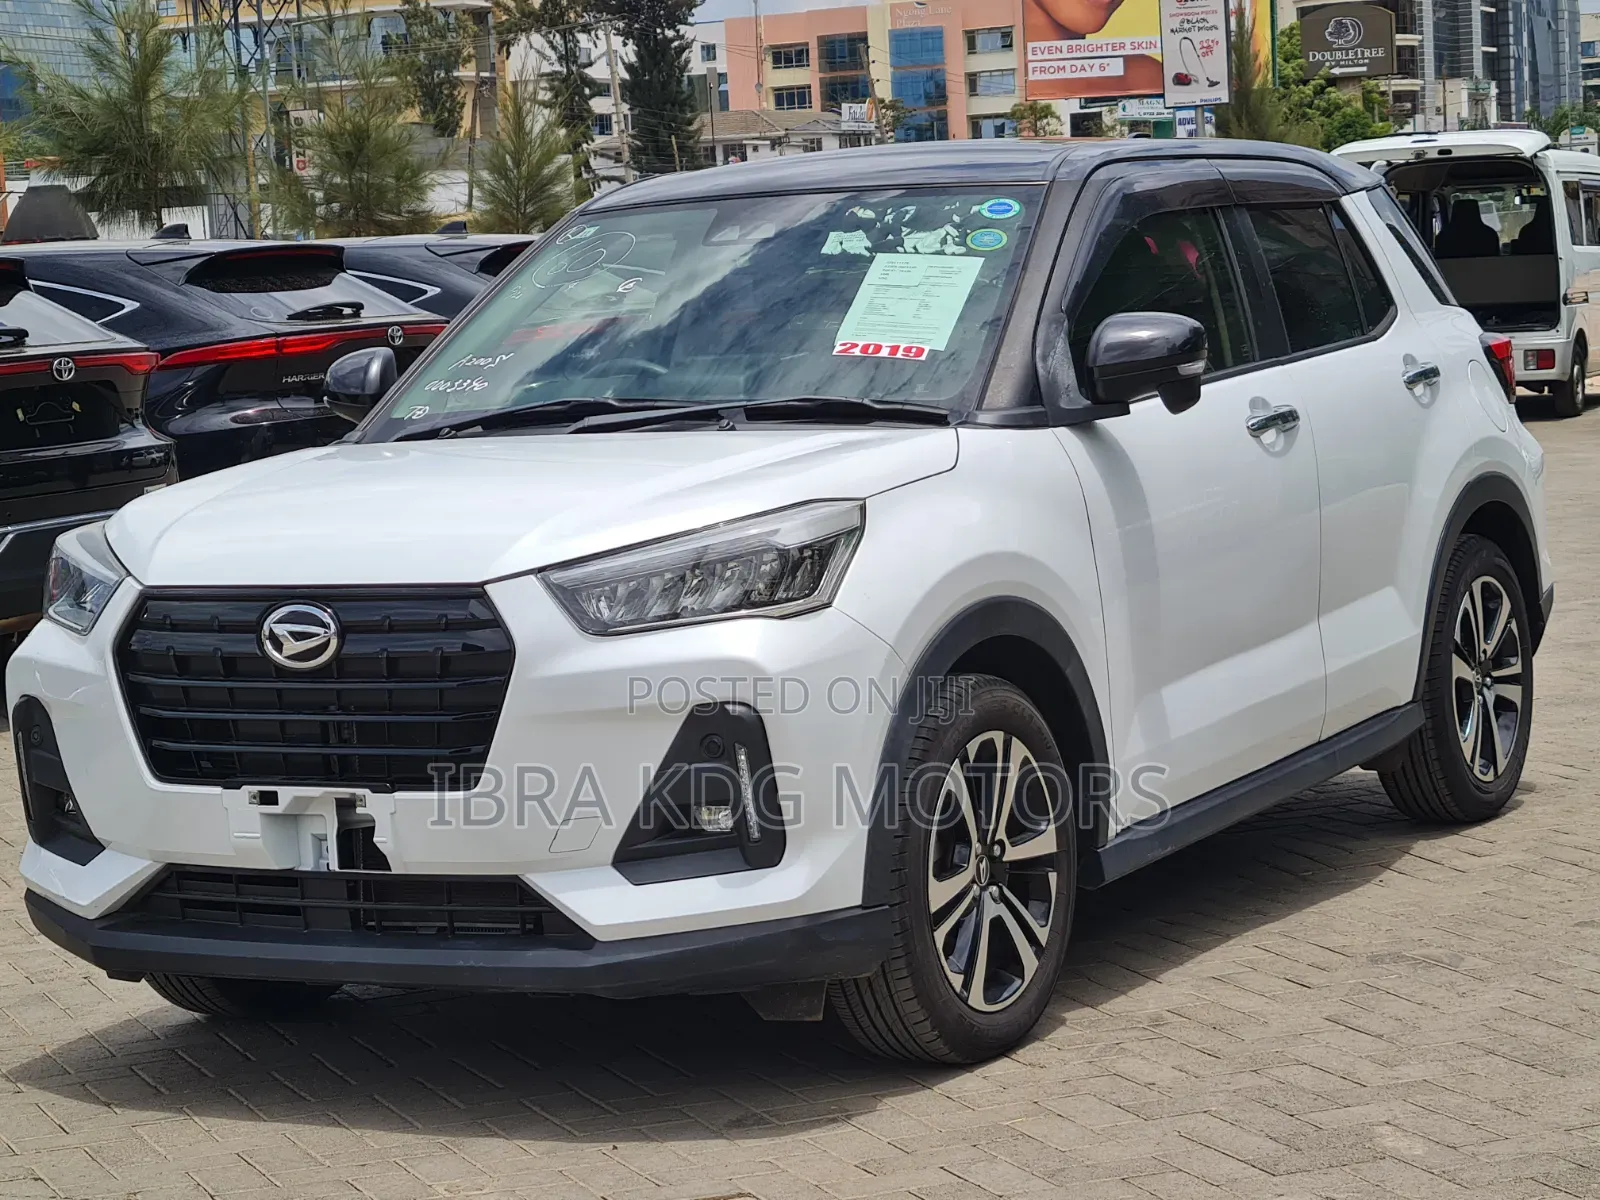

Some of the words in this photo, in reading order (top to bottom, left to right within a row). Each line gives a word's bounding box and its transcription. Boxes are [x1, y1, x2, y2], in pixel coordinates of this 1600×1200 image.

[928, 6, 952, 15] Lane
[1031, 45, 1063, 56] EVEN
[1066, 41, 1126, 54] BRIGHTER
[1129, 40, 1157, 51] SKIN
[1031, 64, 1066, 75] FROM
[1069, 63, 1095, 74] DAY
[835, 342, 926, 359] 2019
[282, 372, 325, 384] HARRIER
